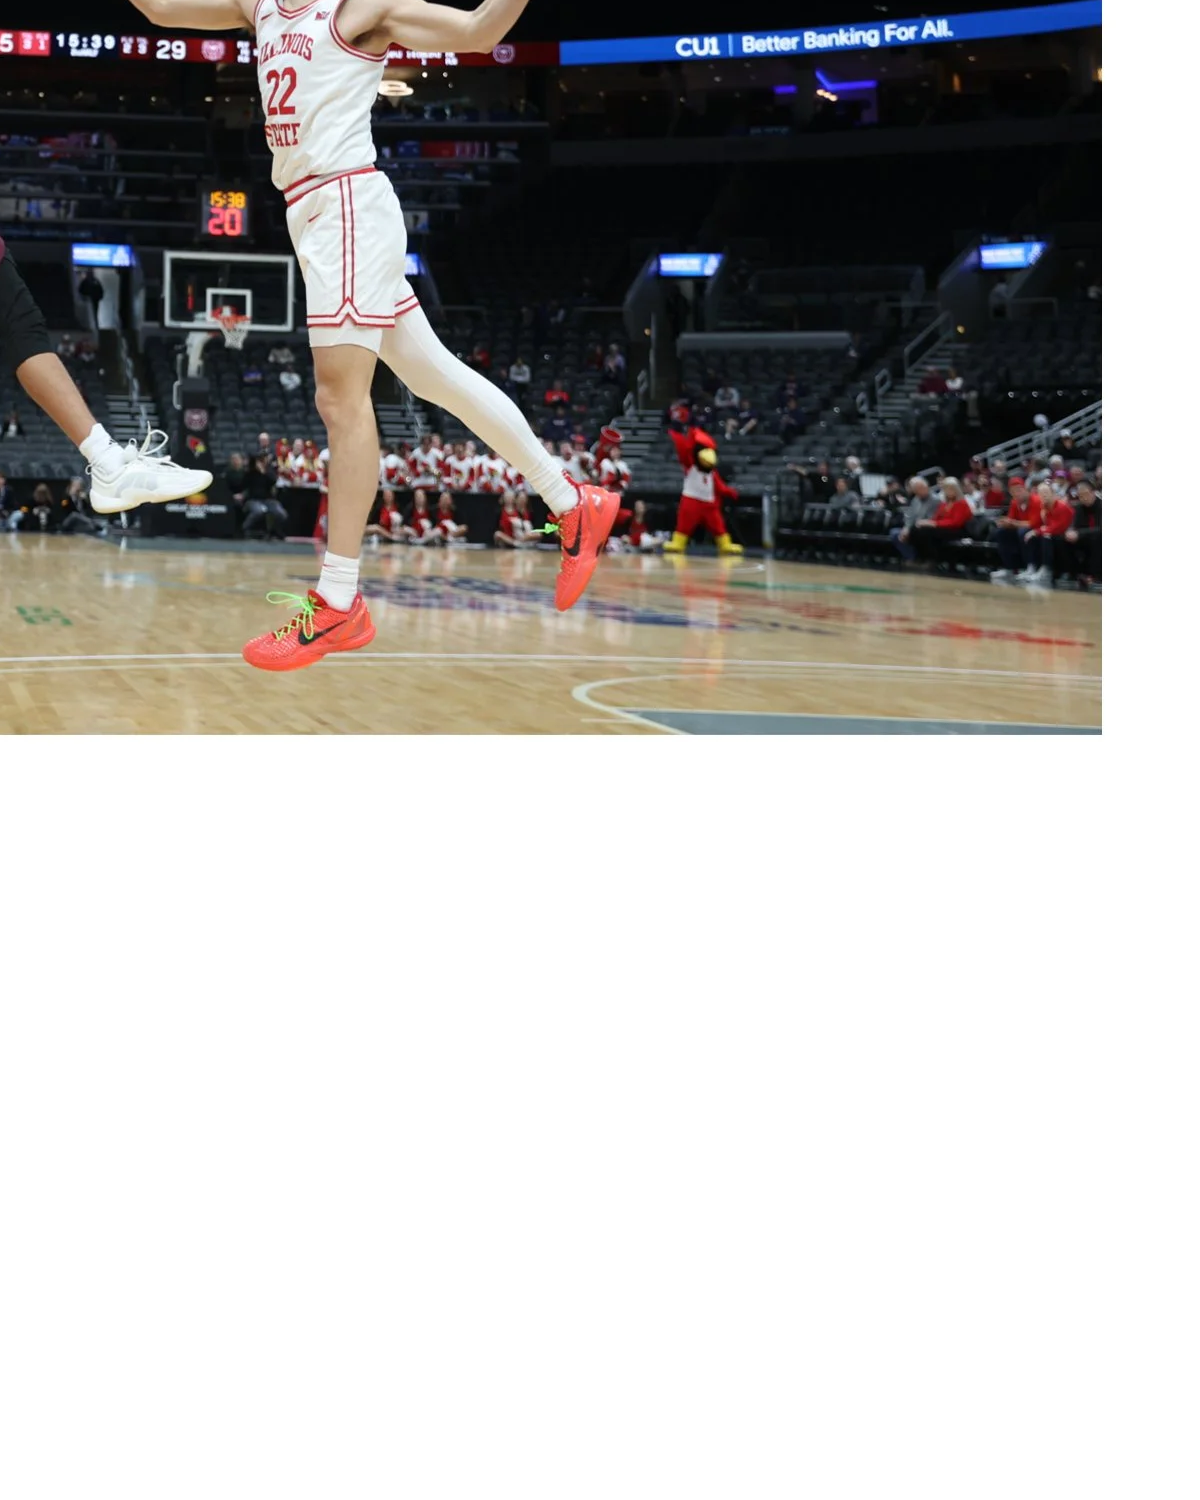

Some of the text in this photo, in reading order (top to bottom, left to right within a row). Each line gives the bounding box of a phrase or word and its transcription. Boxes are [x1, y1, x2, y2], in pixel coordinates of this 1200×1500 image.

[56, 33, 116, 51] 15:39
[155, 39, 187, 61] 29
[675, 19, 954, 57] CU1 Better Banking For All.
[266, 66, 297, 117] 22
[210, 190, 247, 209] 15:38
[207, 207, 242, 237] 20
